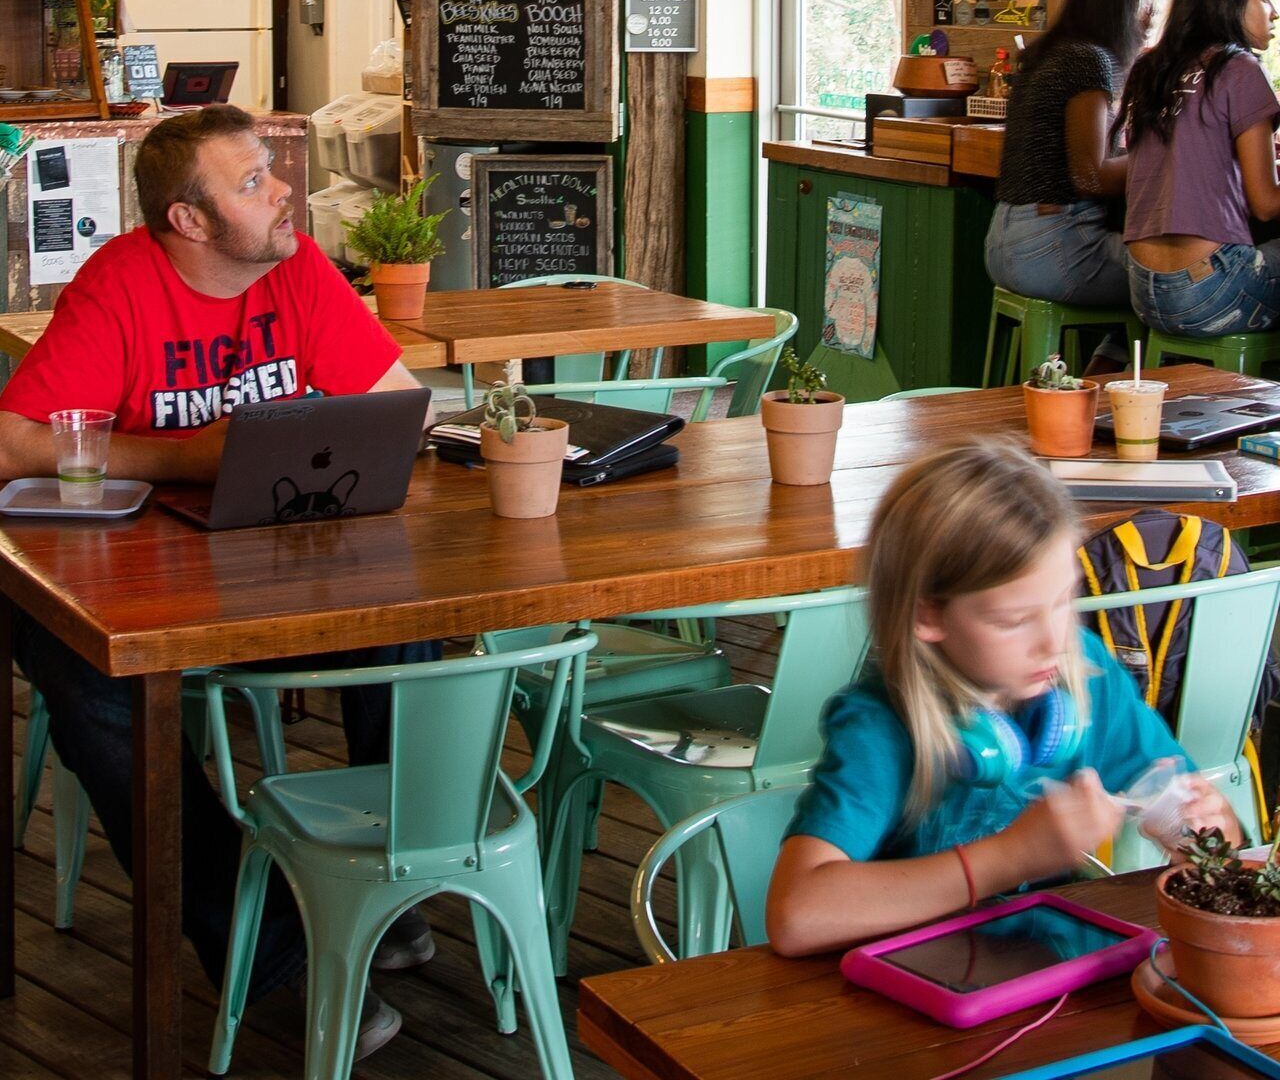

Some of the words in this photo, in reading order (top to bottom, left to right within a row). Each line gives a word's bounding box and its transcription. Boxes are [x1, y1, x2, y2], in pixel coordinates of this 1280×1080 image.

[440, 2, 479, 23] BEES
[526, 4, 582, 22] BOOCH
[649, 6, 661, 15] 12
[663, 6, 679, 15] OZ
[648, 28, 660, 37] 16
[663, 28, 678, 36] OZ
